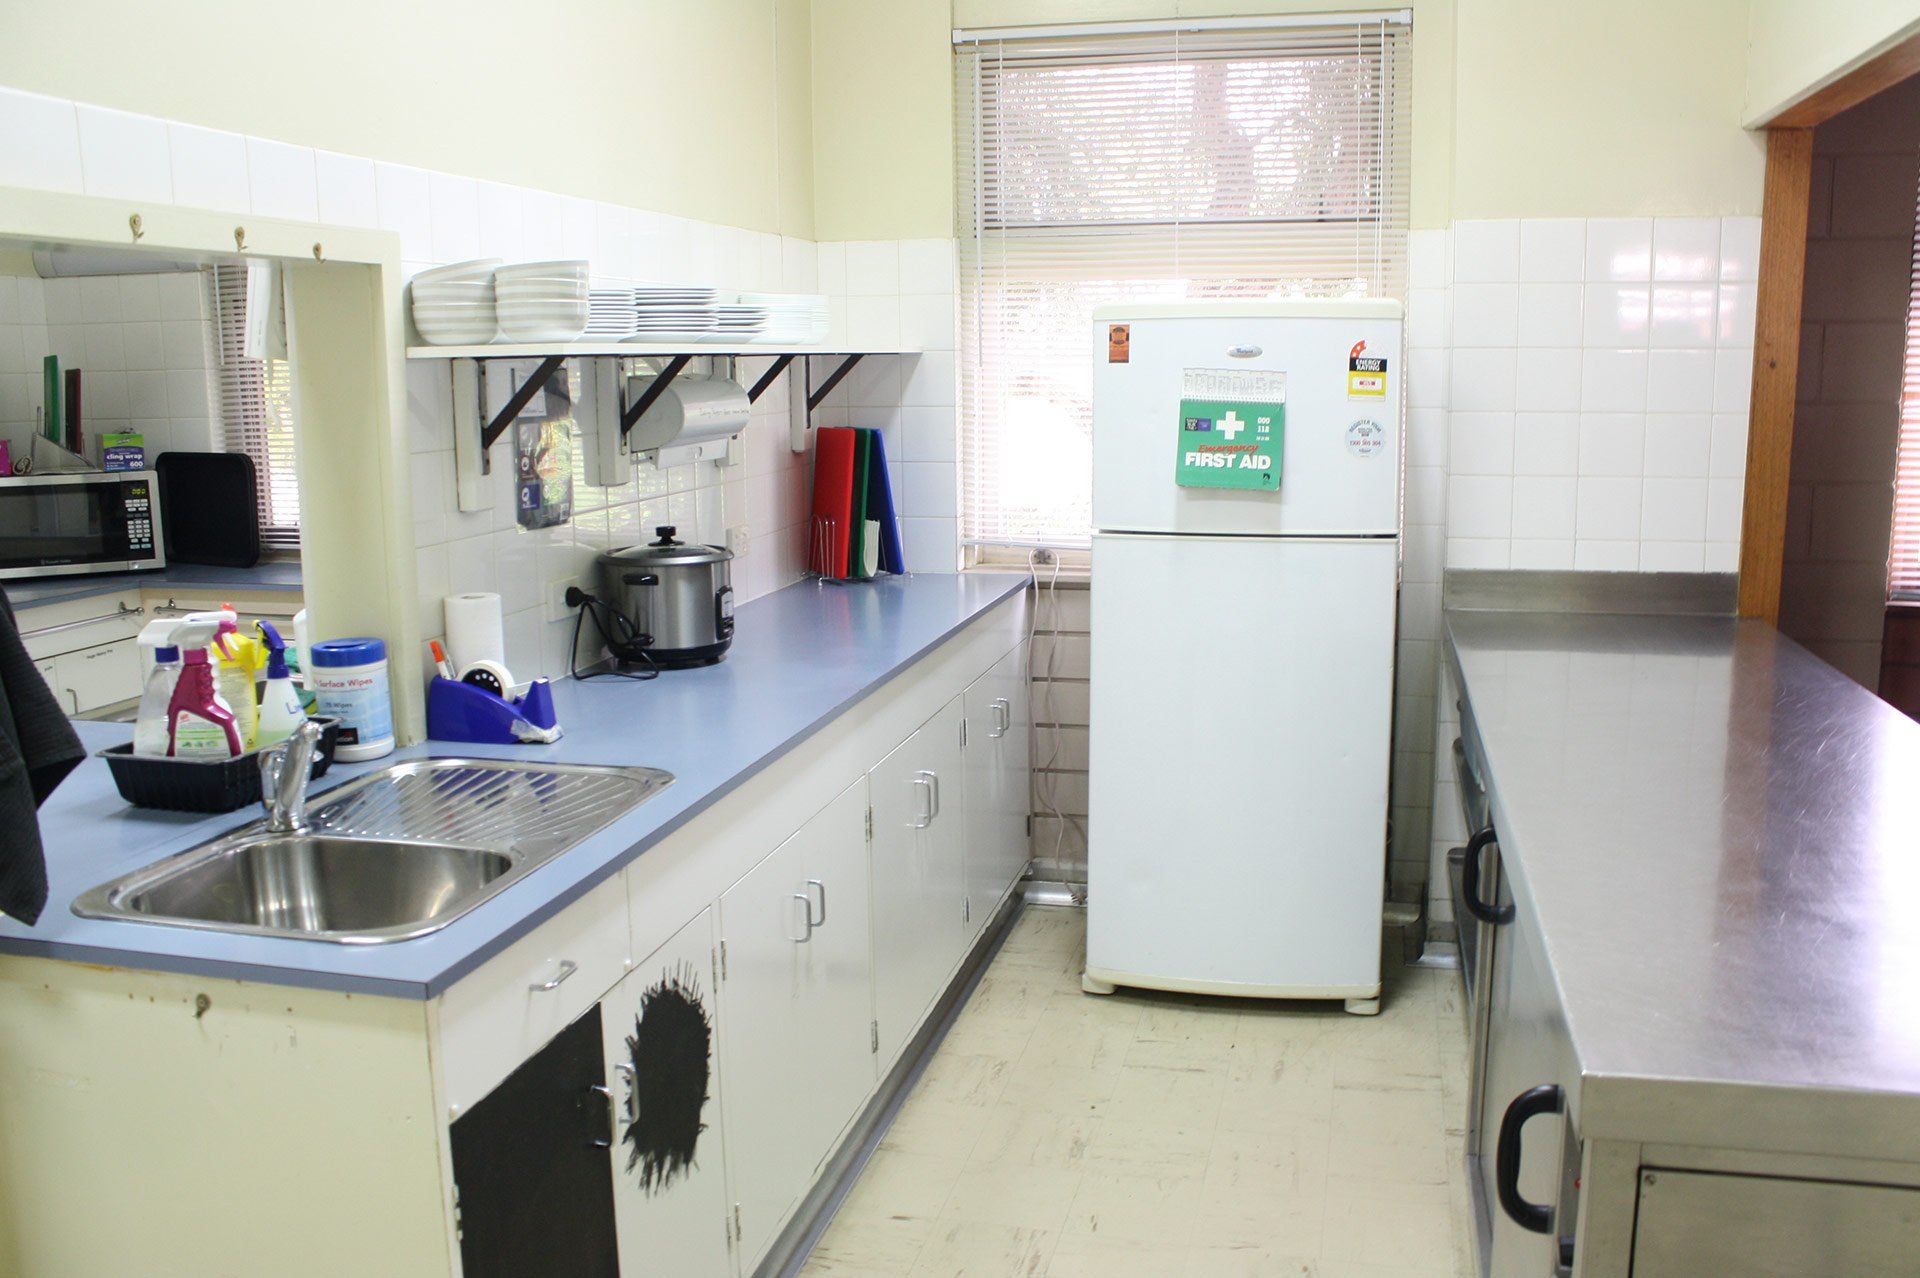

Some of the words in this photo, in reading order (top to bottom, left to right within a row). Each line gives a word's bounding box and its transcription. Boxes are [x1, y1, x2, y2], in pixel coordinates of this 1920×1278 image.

[1257, 416, 1271, 424] 000
[1198, 444, 1260, 455] Emergency
[1185, 452, 1237, 468] FIRST
[1238, 454, 1271, 469] AID
[347, 678, 373, 687] Wipes
